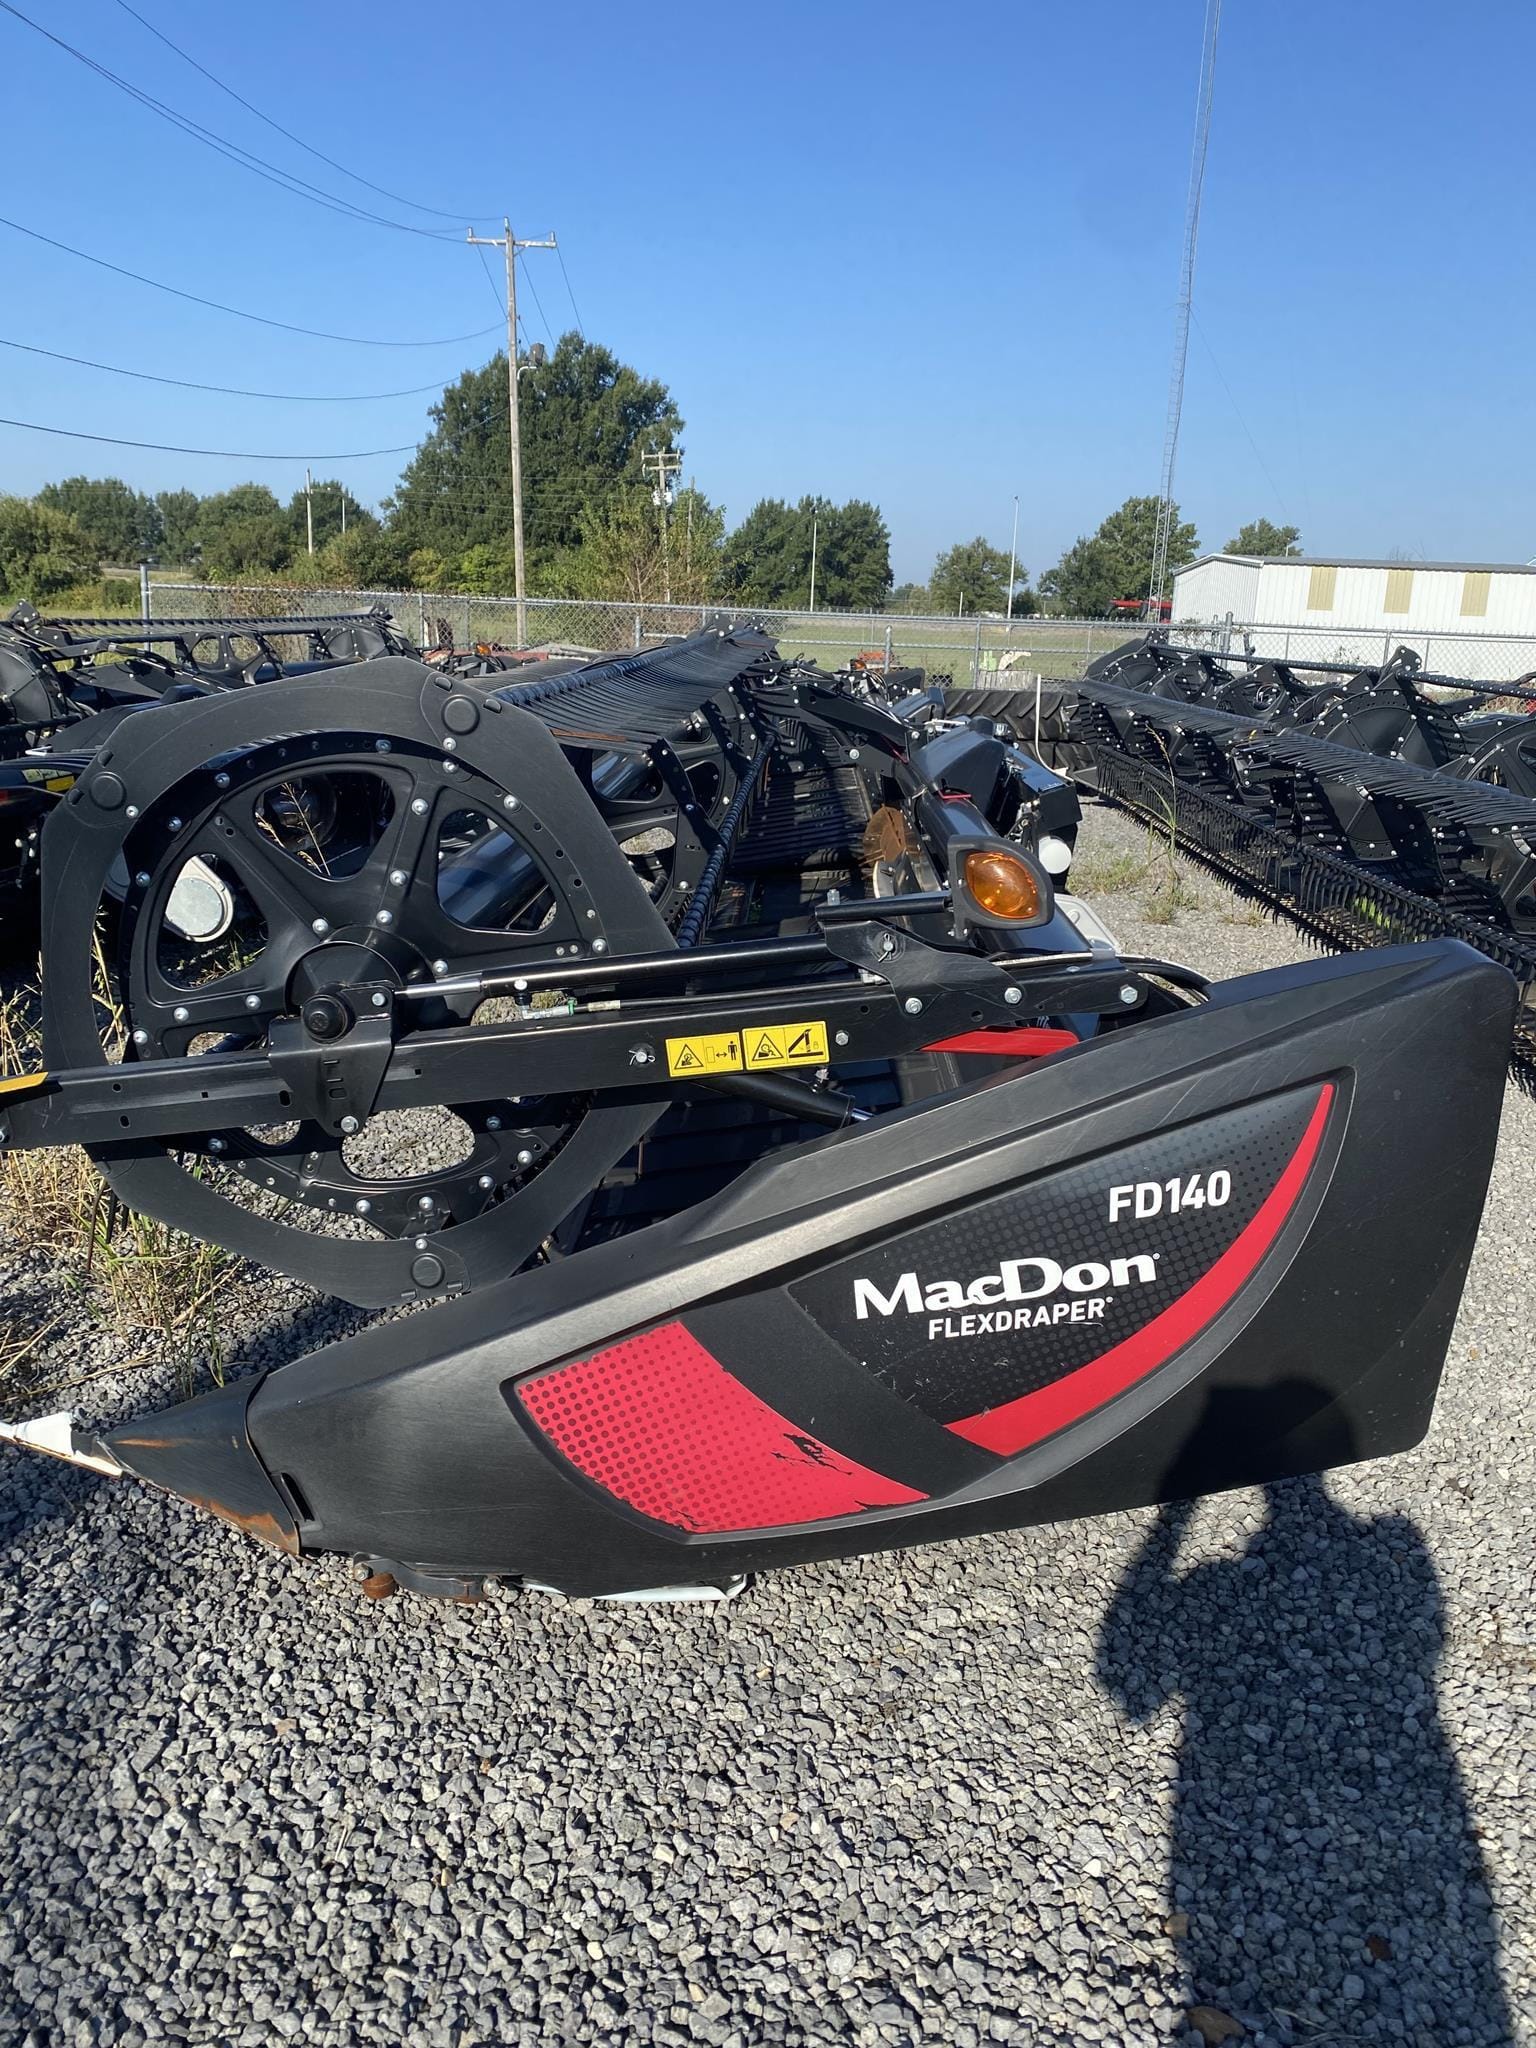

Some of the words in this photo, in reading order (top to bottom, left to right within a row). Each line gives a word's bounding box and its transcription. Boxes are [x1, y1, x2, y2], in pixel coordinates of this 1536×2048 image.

[1109, 1169, 1231, 1223] FD140
[853, 1254, 1157, 1320] MacDon
[928, 1297, 1106, 1340] FLEXDRAPER
